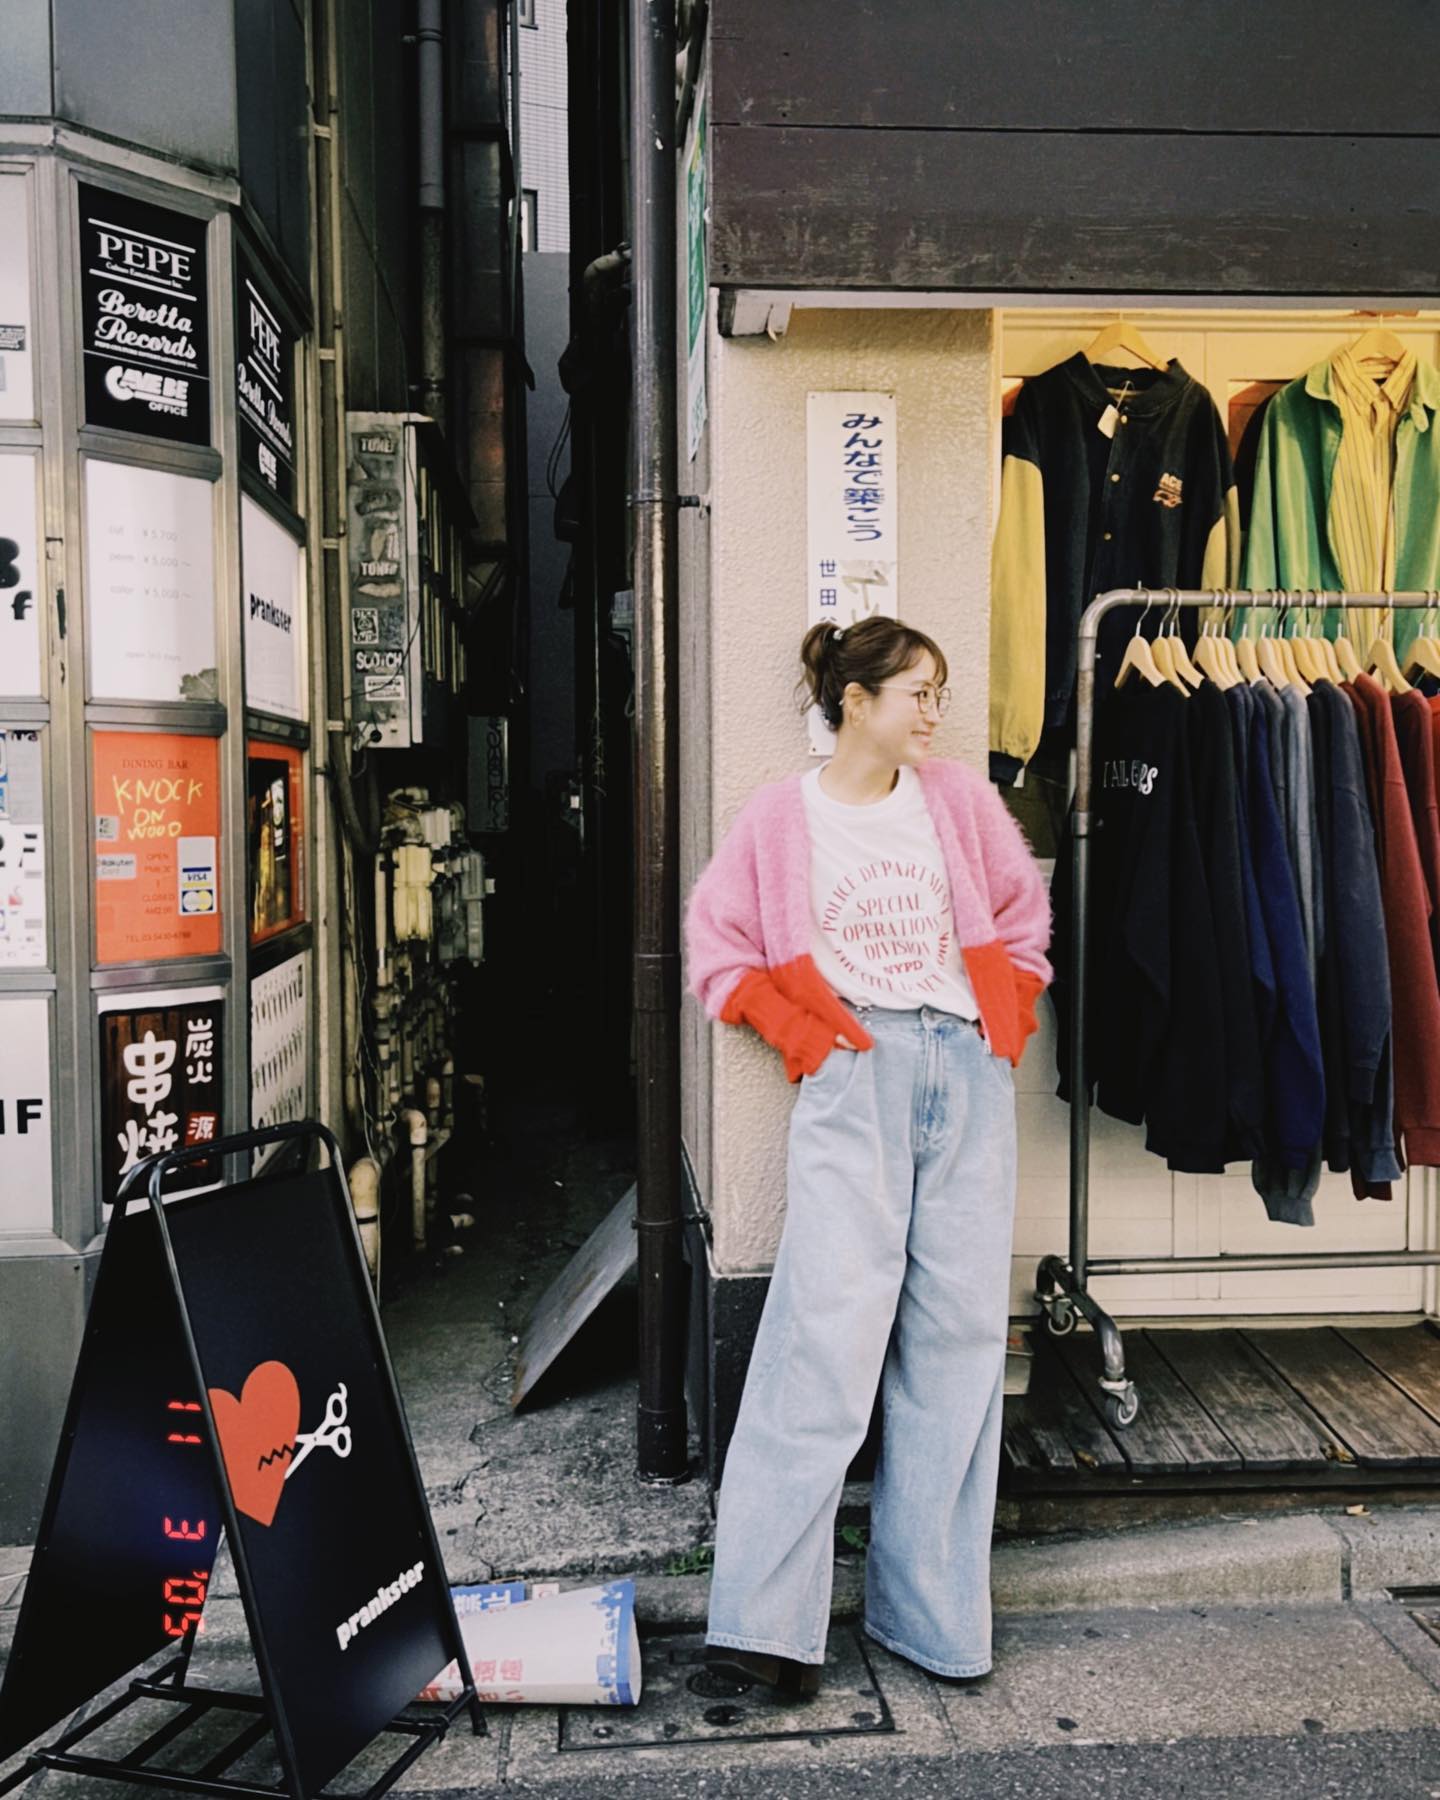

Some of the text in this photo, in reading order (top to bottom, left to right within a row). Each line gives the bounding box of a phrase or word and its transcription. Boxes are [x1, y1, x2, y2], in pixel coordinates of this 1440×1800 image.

[96, 231, 191, 281] PEPE
[98, 289, 193, 333] Beretta
[95, 315, 197, 360] Records
[249, 299, 281, 373] PEPE
[148, 401, 188, 417] OFFICE
[841, 413, 885, 542] みんなで築こう
[819, 559, 838, 623] 世田
[250, 593, 292, 634] prankster
[121, 759, 189, 771] DINING BAR
[112, 773, 203, 816] KNOCK
[128, 821, 183, 840] WOOD
[134, 807, 166, 827] ON
[187, 873, 208, 882] VISA
[822, 875, 857, 933] POLICE
[856, 892, 921, 918] SPECIAL
[864, 939, 931, 961] DIVISION
[882, 959, 924, 975] NYPD
[185, 1018, 214, 1084] 炭火
[335, 1561, 425, 1651] prankster
